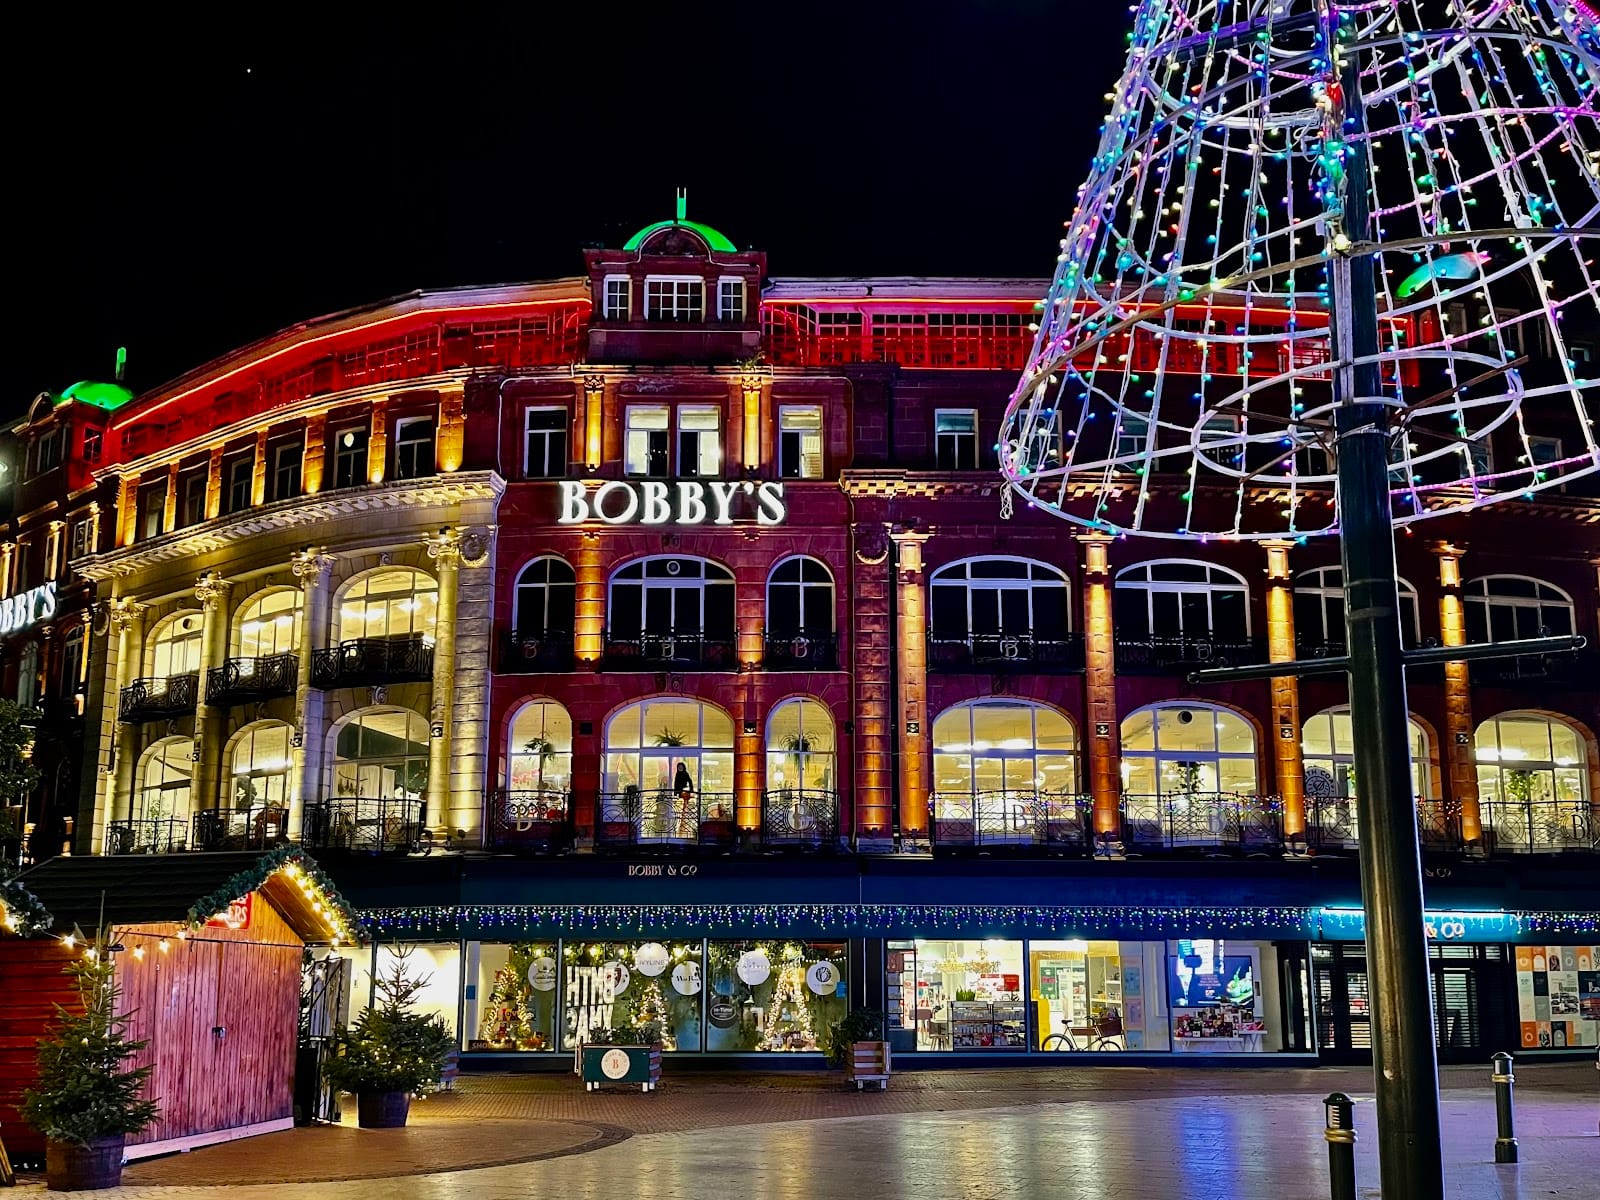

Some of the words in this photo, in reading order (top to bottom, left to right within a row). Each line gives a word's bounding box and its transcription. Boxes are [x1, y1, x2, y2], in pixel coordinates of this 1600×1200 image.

[558, 480, 786, 525] BOBBY'S
[628, 864, 664, 877] BOBBY
[667, 864, 677, 876] &
